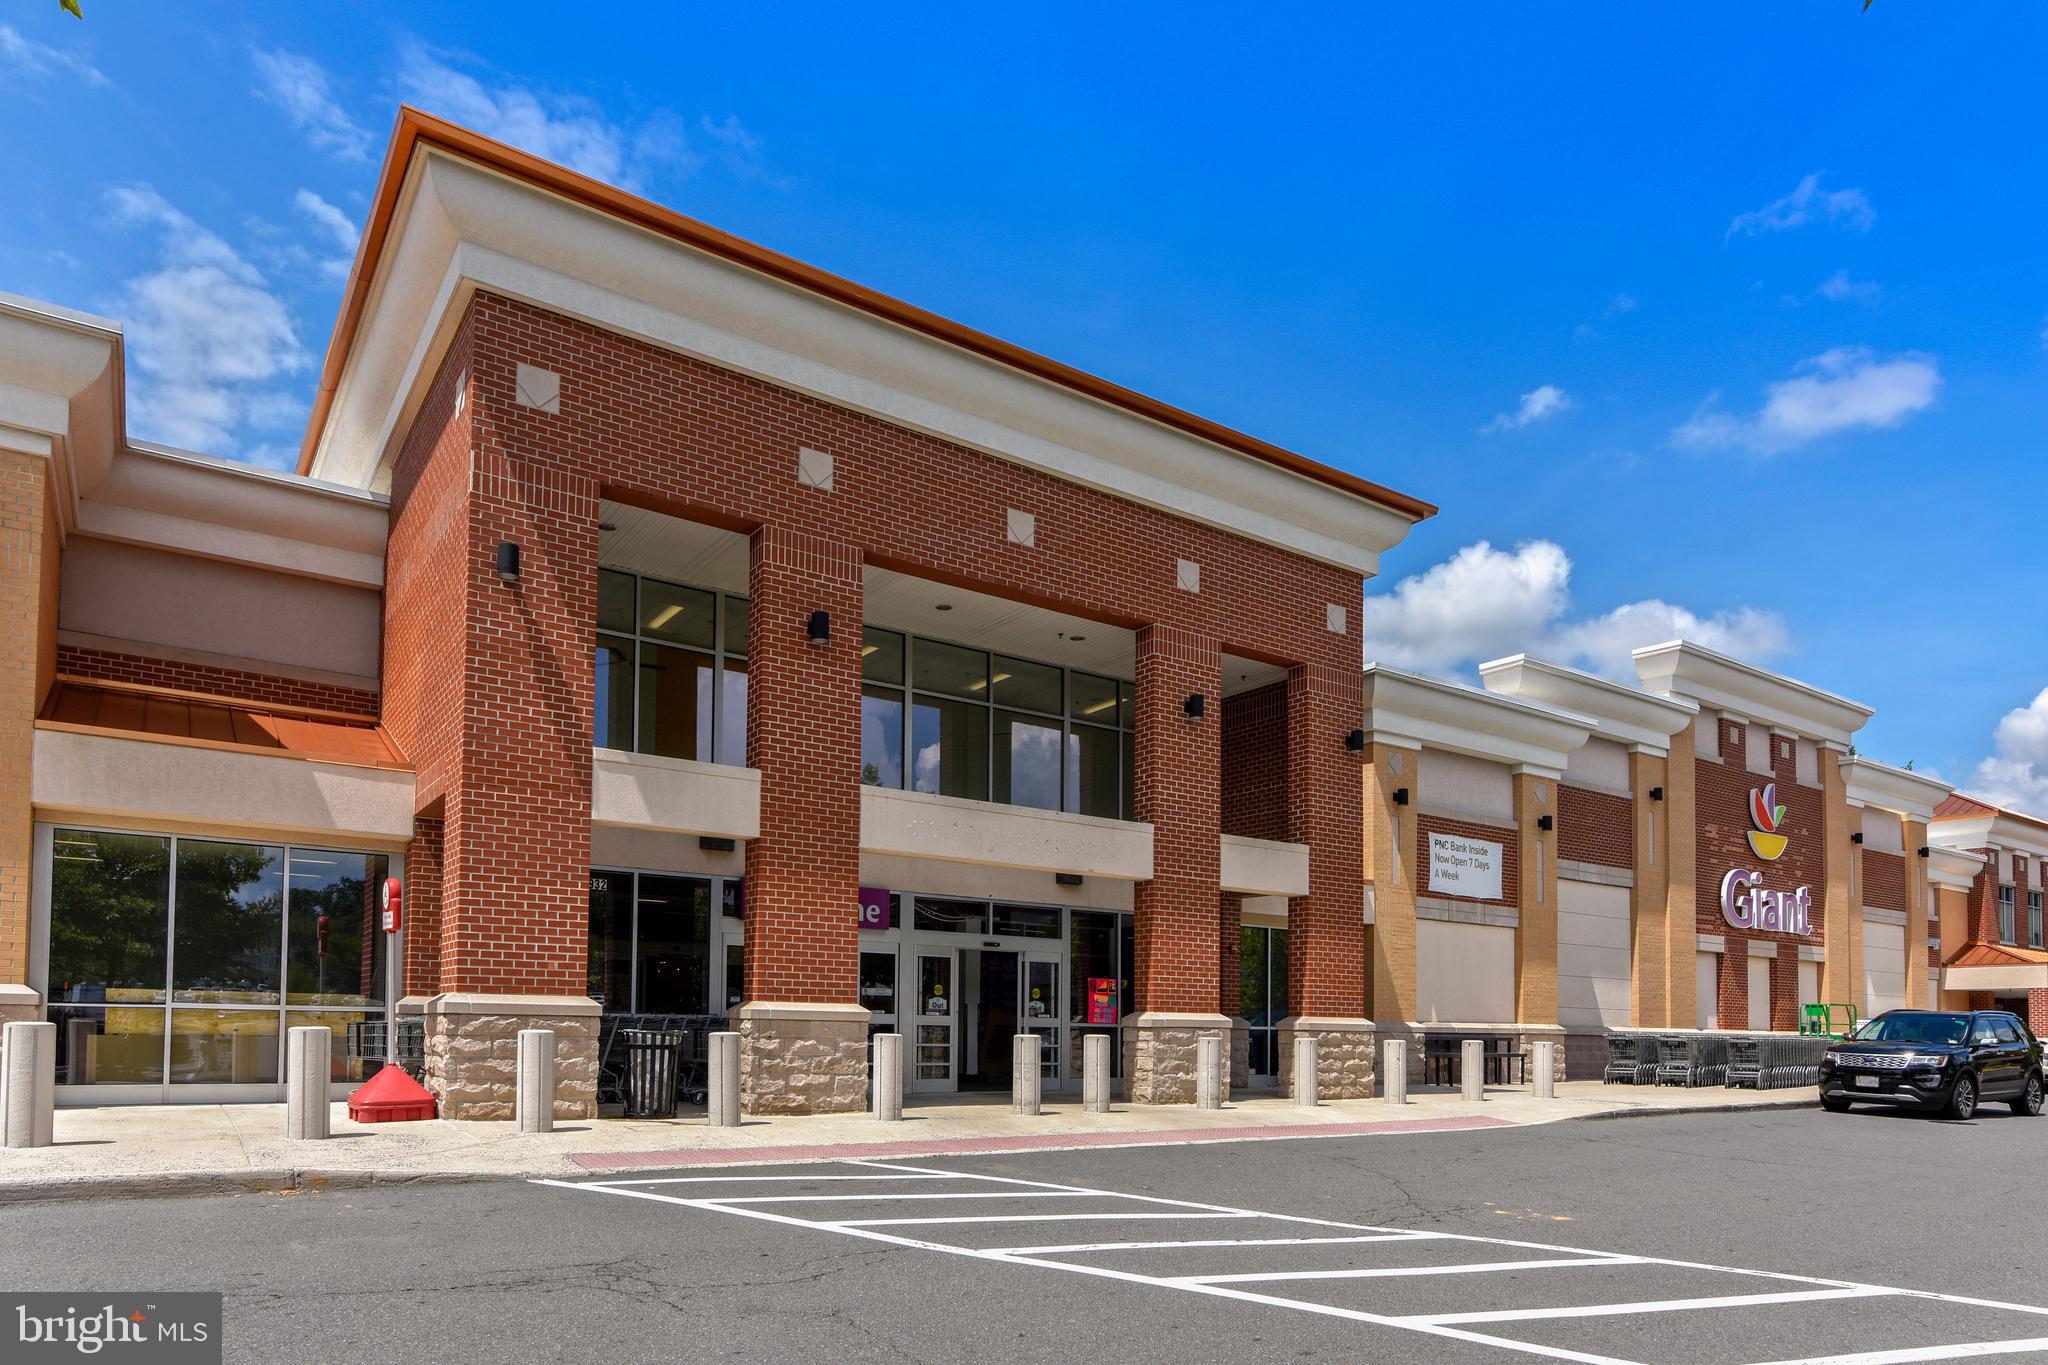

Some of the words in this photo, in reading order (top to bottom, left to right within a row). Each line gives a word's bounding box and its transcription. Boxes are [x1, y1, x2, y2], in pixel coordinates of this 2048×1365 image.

[1434, 839, 1449, 851] PNC
[1450, 841, 1467, 854] Bank
[1469, 844, 1488, 856] Inside
[1434, 852, 1450, 864] Now
[1450, 855, 1467, 868] Open
[1468, 857, 1473, 867] 7
[1474, 859, 1490, 872] Days
[1434, 868, 1440, 878] A
[1441, 869, 1460, 881] Week
[1721, 868, 1813, 936] Giant
